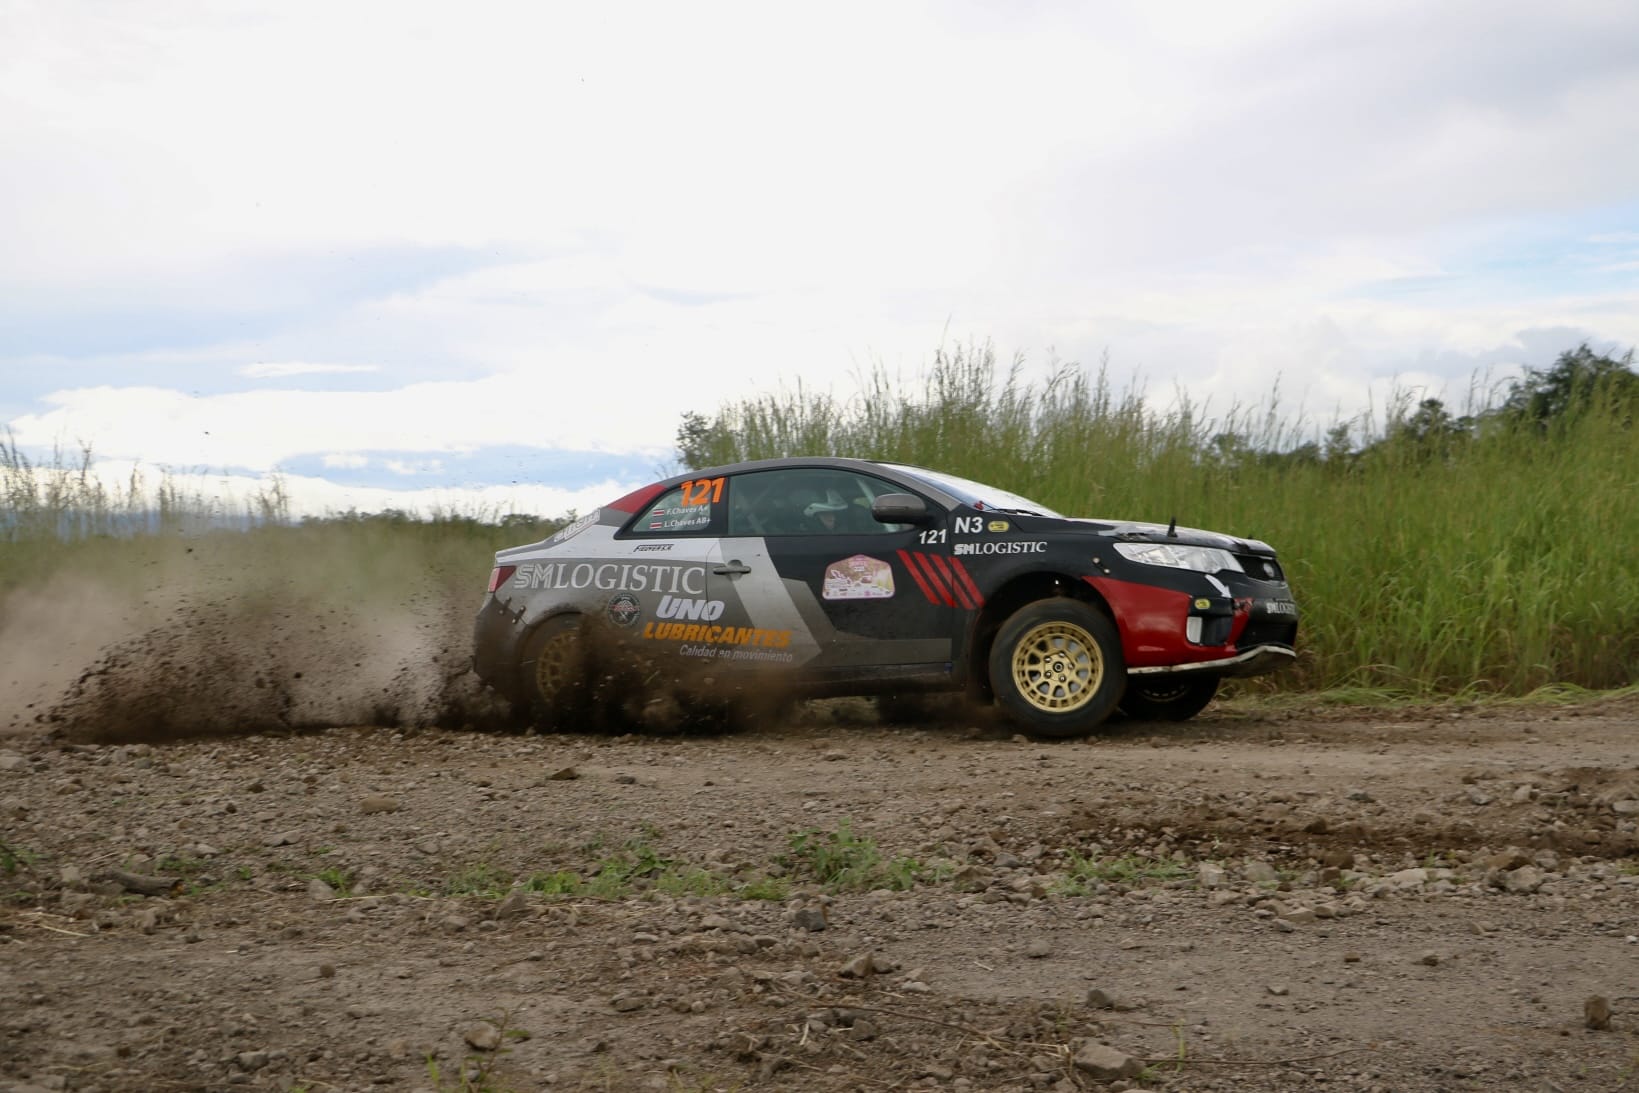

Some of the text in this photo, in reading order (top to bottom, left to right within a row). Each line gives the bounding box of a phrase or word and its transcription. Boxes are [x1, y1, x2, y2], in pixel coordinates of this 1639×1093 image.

[681, 477, 726, 507] 121
[954, 516, 983, 534] N3
[919, 529, 947, 545] 121
[656, 595, 725, 621] UNO
[643, 622, 792, 647] LUBRICANTES
[680, 644, 716, 658] Calidad
[733, 650, 793, 663] movimiento
